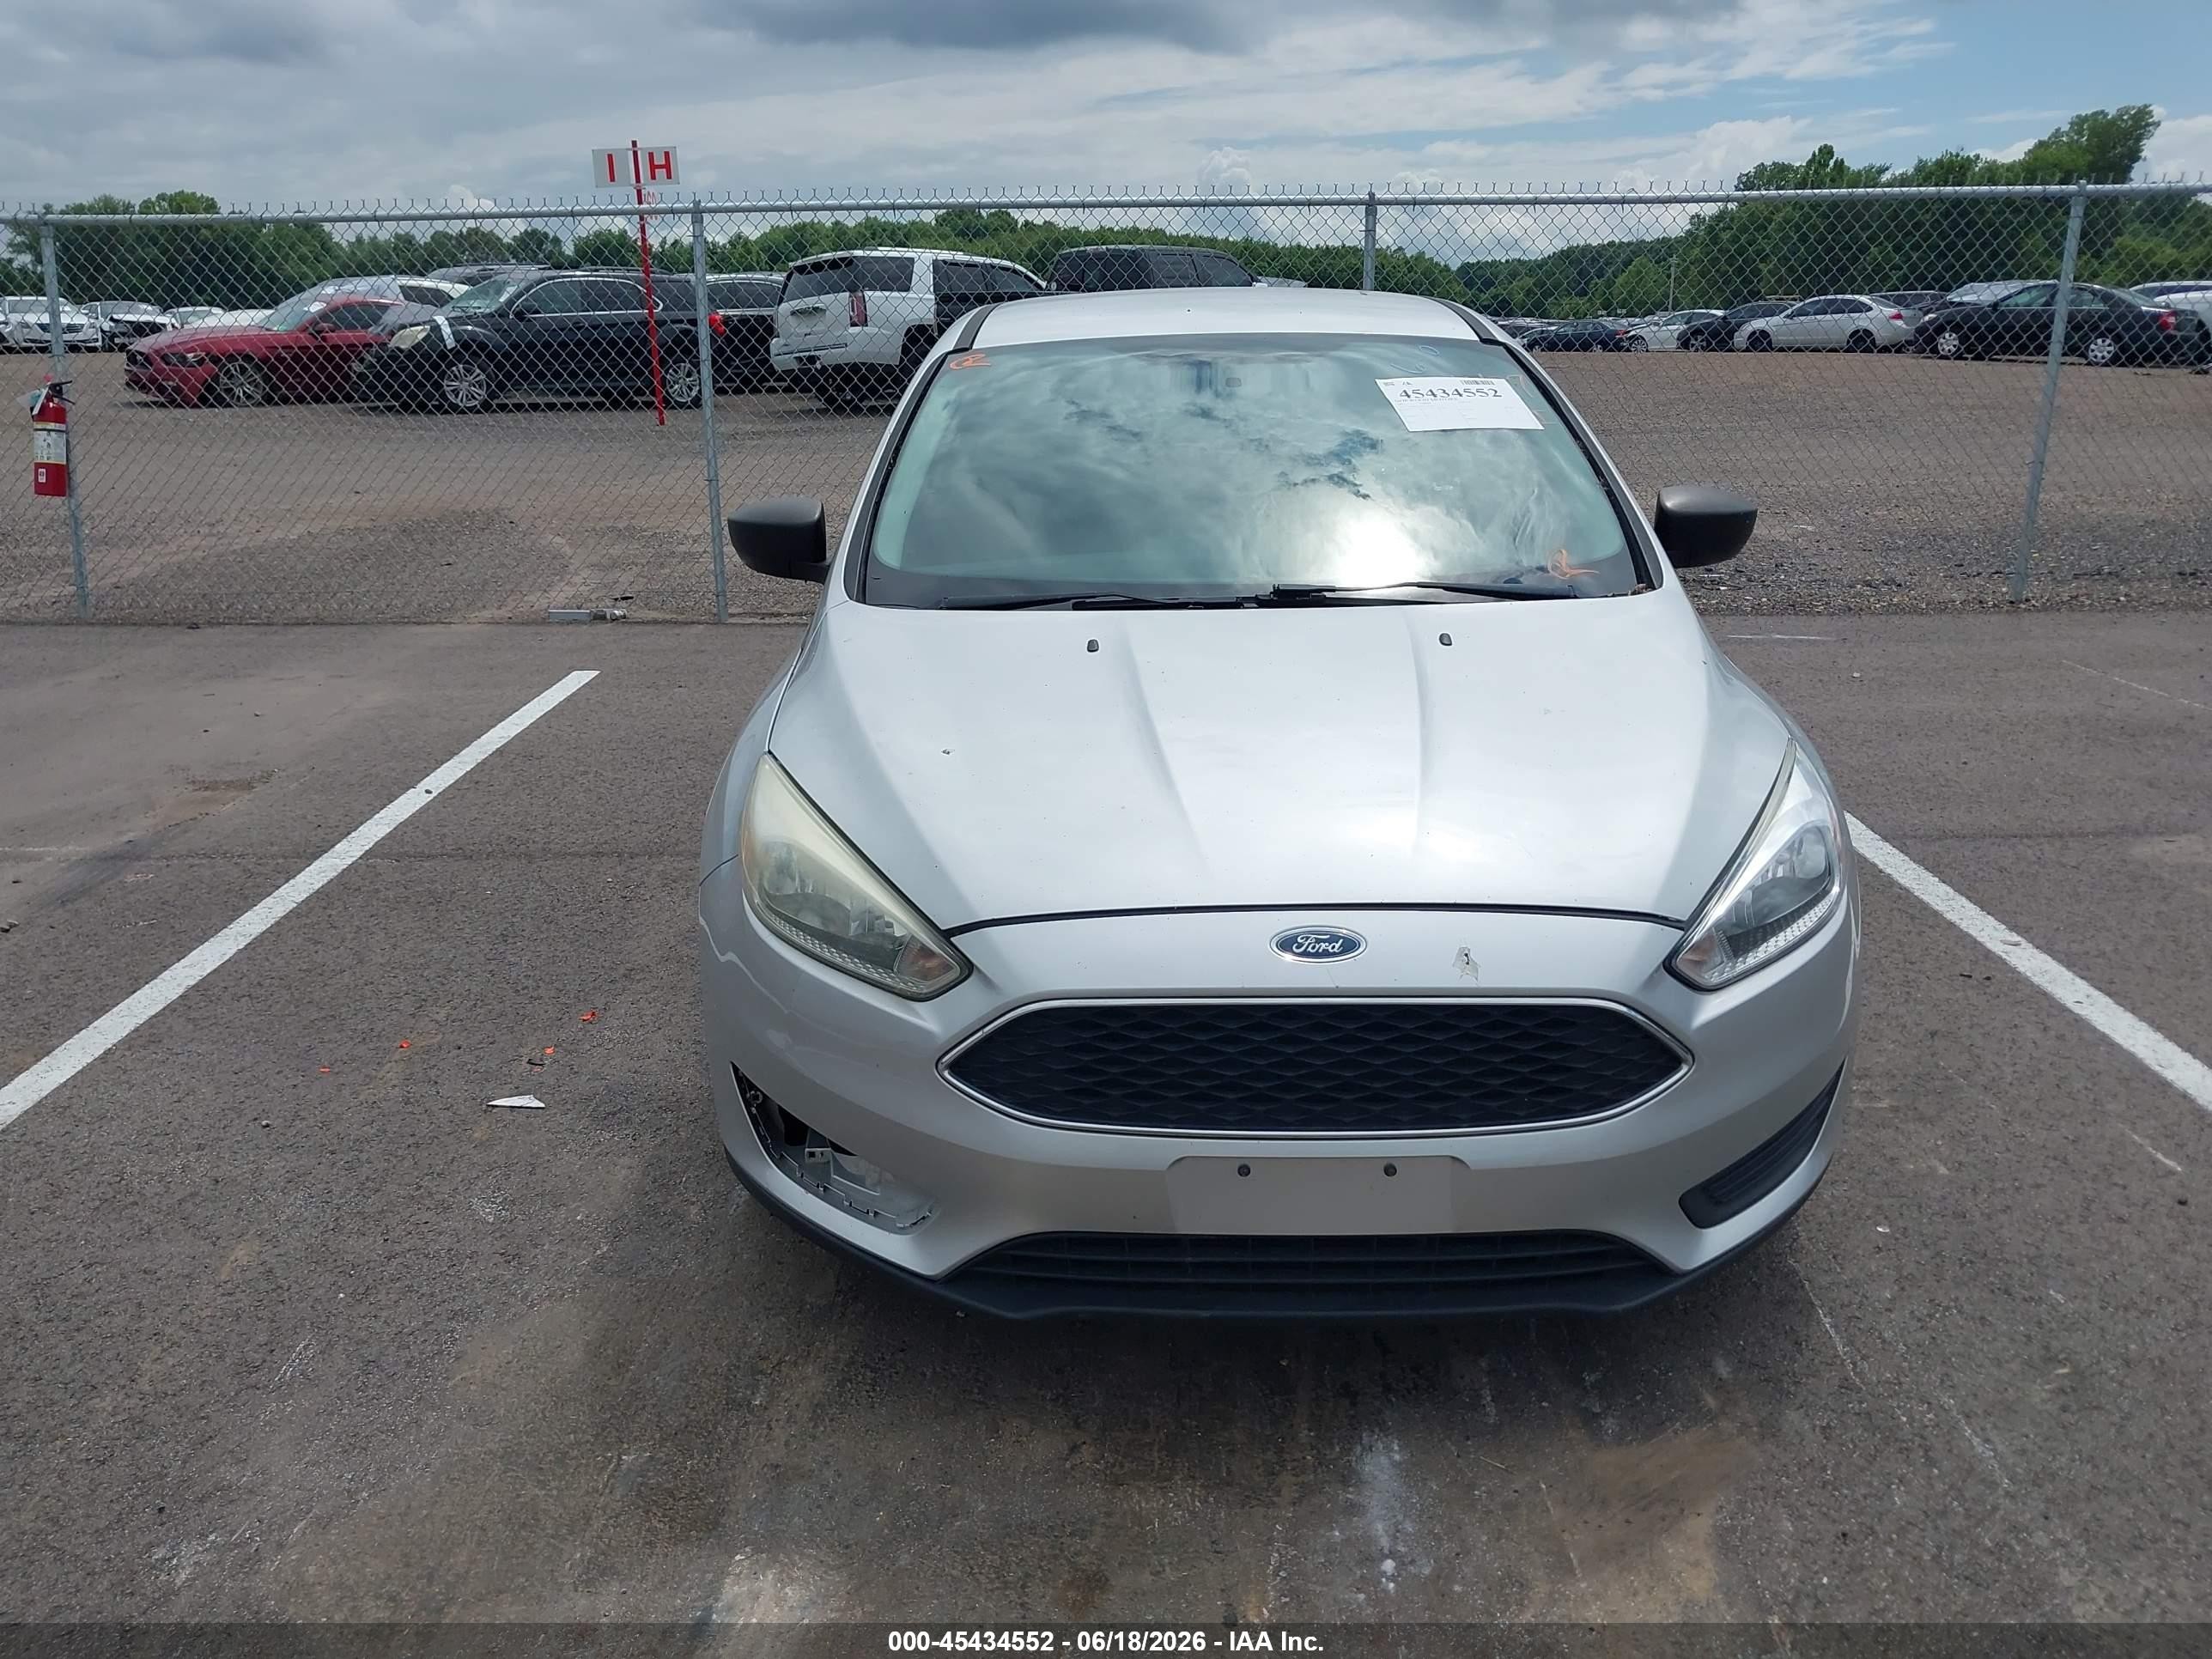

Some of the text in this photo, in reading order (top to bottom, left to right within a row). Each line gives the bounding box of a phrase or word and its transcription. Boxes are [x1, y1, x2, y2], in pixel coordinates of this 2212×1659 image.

[647, 150, 672, 180] H
[1399, 387, 1504, 399] 45434552
[1291, 933, 1344, 953] Ford
